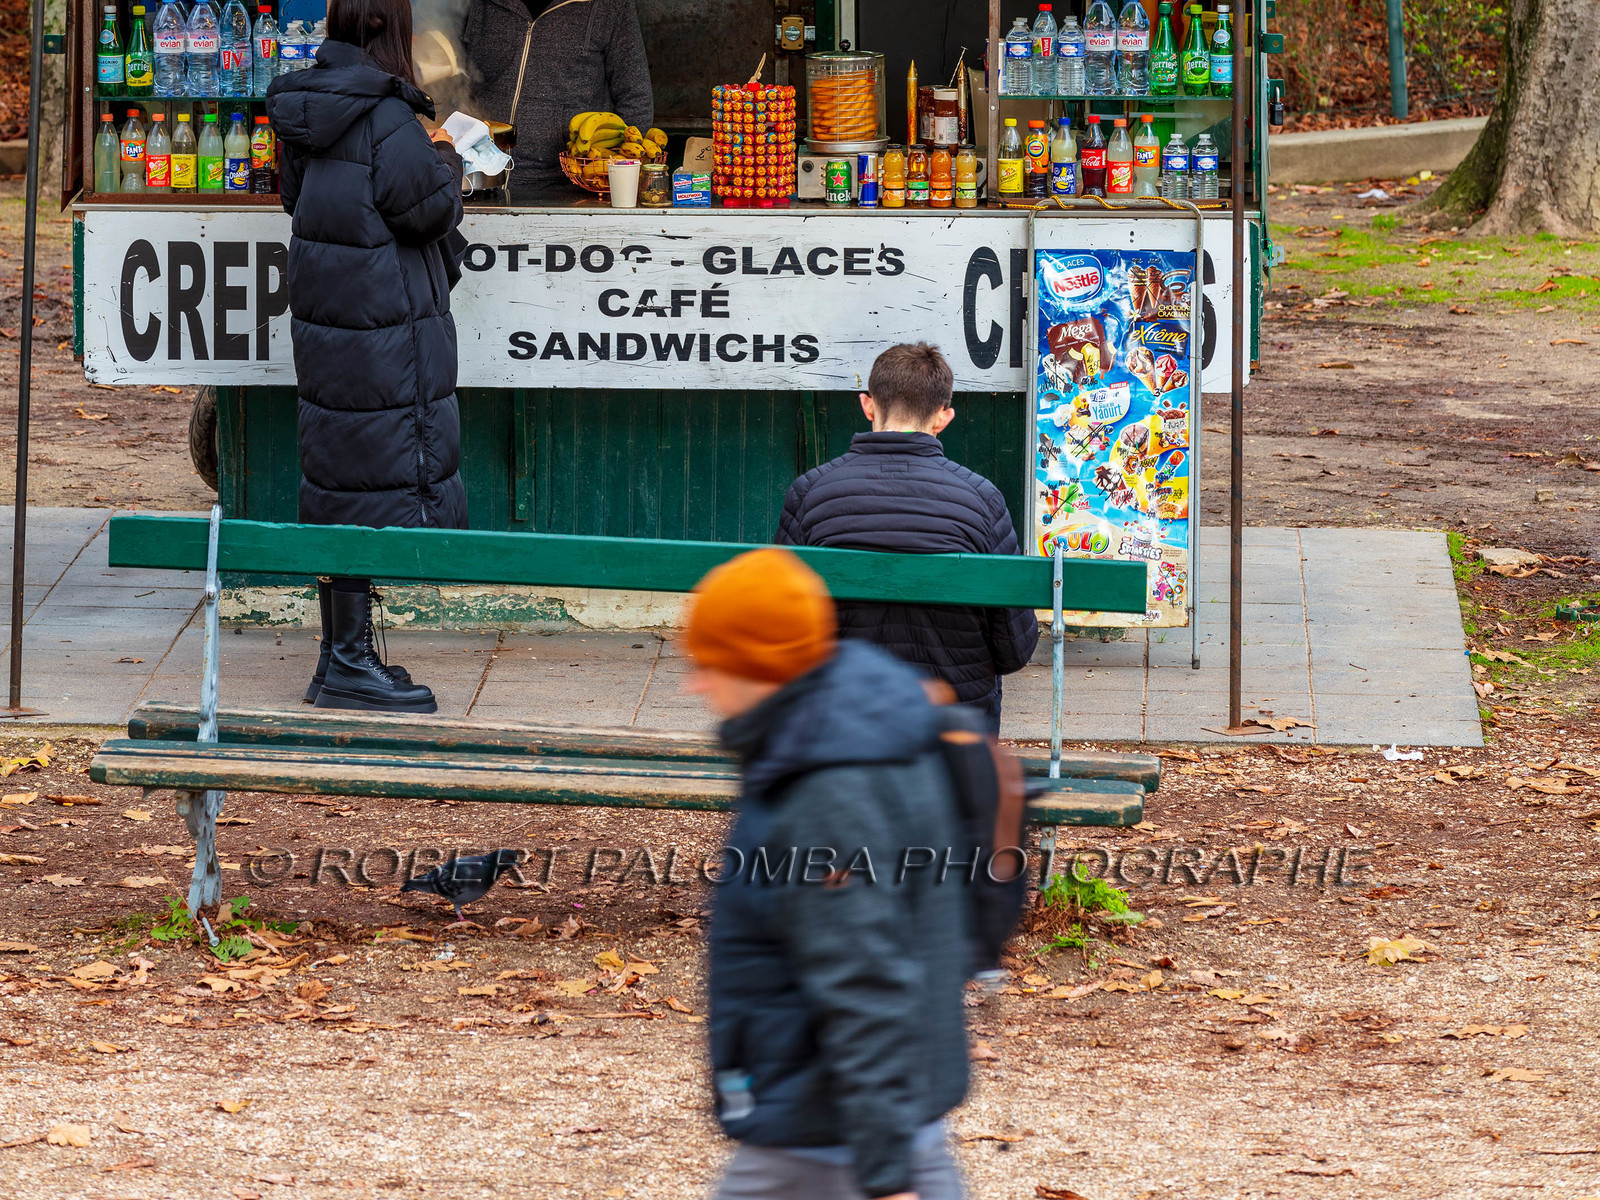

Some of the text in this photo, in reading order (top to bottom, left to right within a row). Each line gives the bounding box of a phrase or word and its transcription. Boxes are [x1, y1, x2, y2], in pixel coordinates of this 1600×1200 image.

[160, 40, 181, 48] evian
[193, 40, 214, 48] evian
[1089, 38, 1111, 46] evian
[1121, 38, 1143, 46] evian
[125, 145, 144, 155] FANTA
[1136, 149, 1154, 160] FANTA
[463, 243, 653, 273] OT-DOG
[702, 245, 906, 277] GLACES
[120, 238, 291, 362] CREP
[597, 282, 731, 319] CAFÉ
[1057, 323, 1093, 343] Mega
[508, 331, 820, 363] SANDWICHS
[1091, 403, 1123, 421] Yaourt
